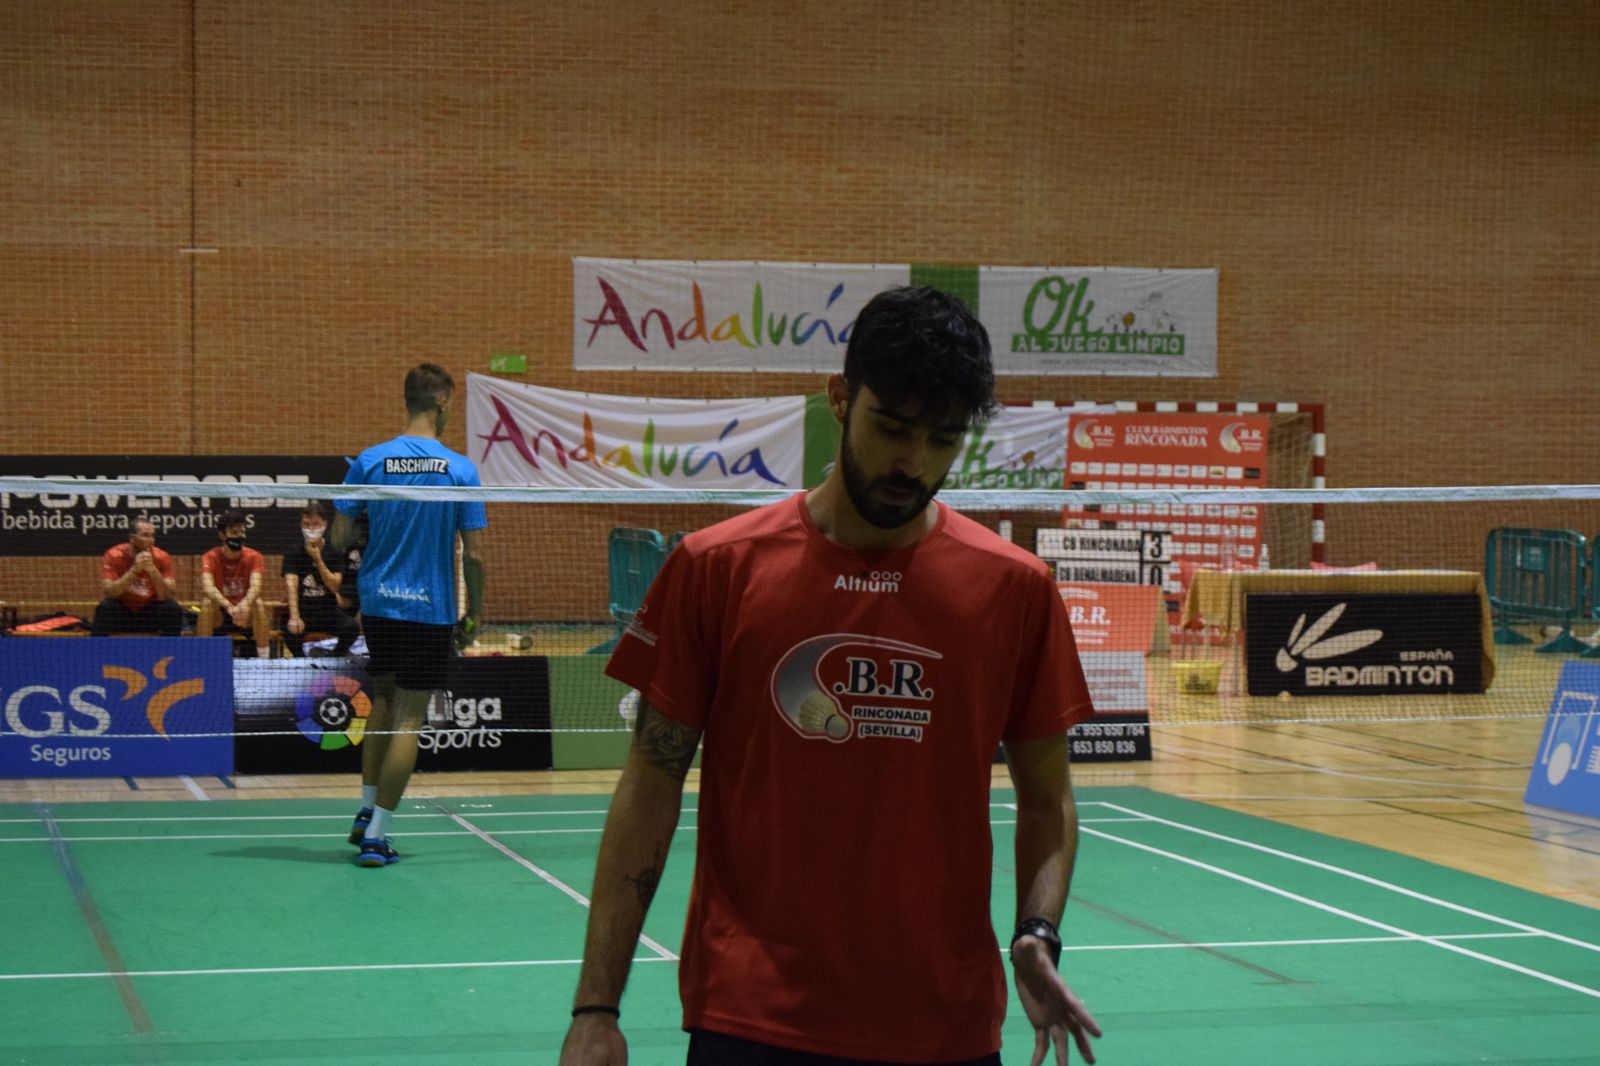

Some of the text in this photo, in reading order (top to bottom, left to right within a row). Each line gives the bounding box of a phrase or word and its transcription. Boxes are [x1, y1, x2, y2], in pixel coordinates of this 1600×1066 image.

[1023, 275, 1104, 336] Ok
[1017, 336, 1181, 354] AL JUEGO LIMPIO
[476, 394, 787, 486] Andalucía
[1124, 433, 1208, 447] RINCONADA
[386, 458, 447, 474] BASCHWITZ
[2, 509, 75, 530] bebida
[81, 513, 129, 535] para
[1079, 536, 1141, 553] RINCONADA
[1150, 534, 1162, 559] 3
[834, 574, 899, 593] Altium
[1400, 648, 1454, 662] ESPAÑA
[1305, 664, 1454, 687] BADMINTON
[0, 685, 111, 738] GS
[853, 707, 930, 723] RINCONADA
[417, 725, 502, 753] Sports
[859, 724, 921, 740] (SEVILLA)
[30, 744, 112, 767] Seguros
[1073, 740, 1137, 754] 653 850 836
